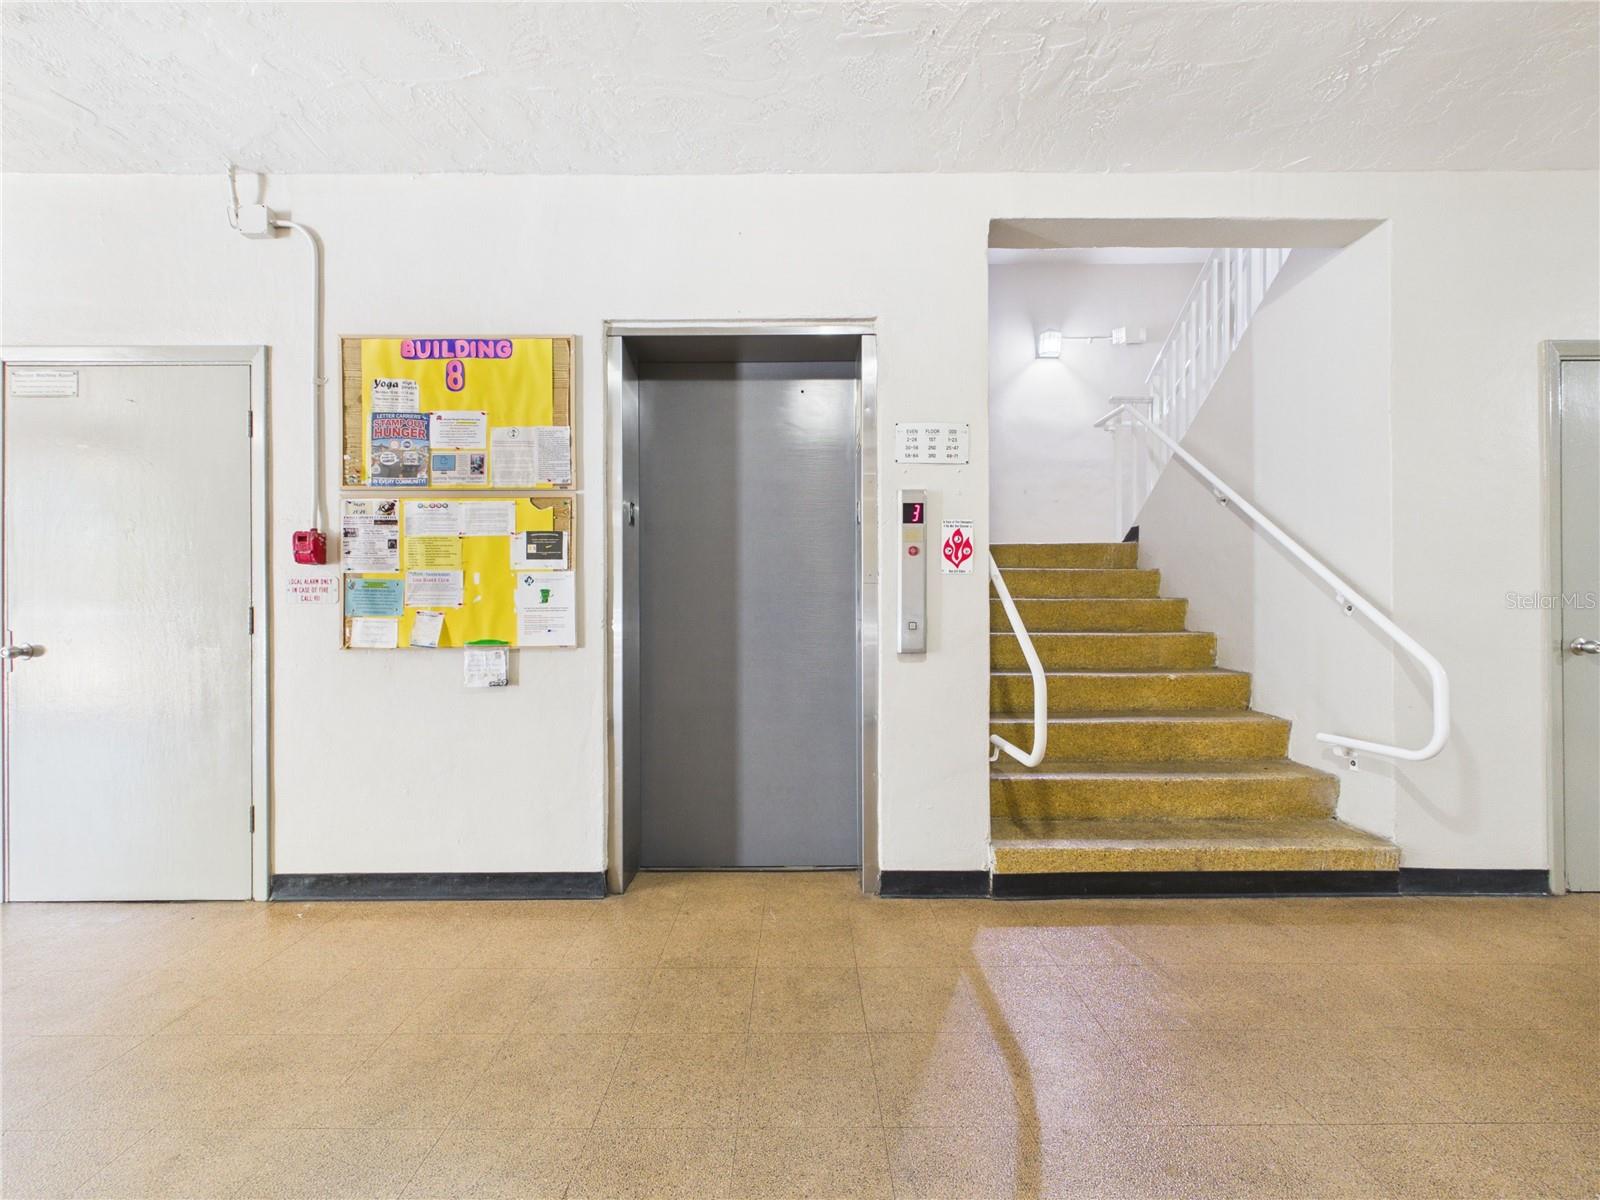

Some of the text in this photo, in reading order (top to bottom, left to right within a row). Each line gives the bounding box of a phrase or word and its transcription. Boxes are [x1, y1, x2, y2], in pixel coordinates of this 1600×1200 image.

[401, 339, 512, 359] BUILDING
[446, 360, 465, 391] 8
[374, 419, 427, 428] STAMP OUT
[374, 428, 426, 439] HUNGER
[912, 504, 920, 522] 3
